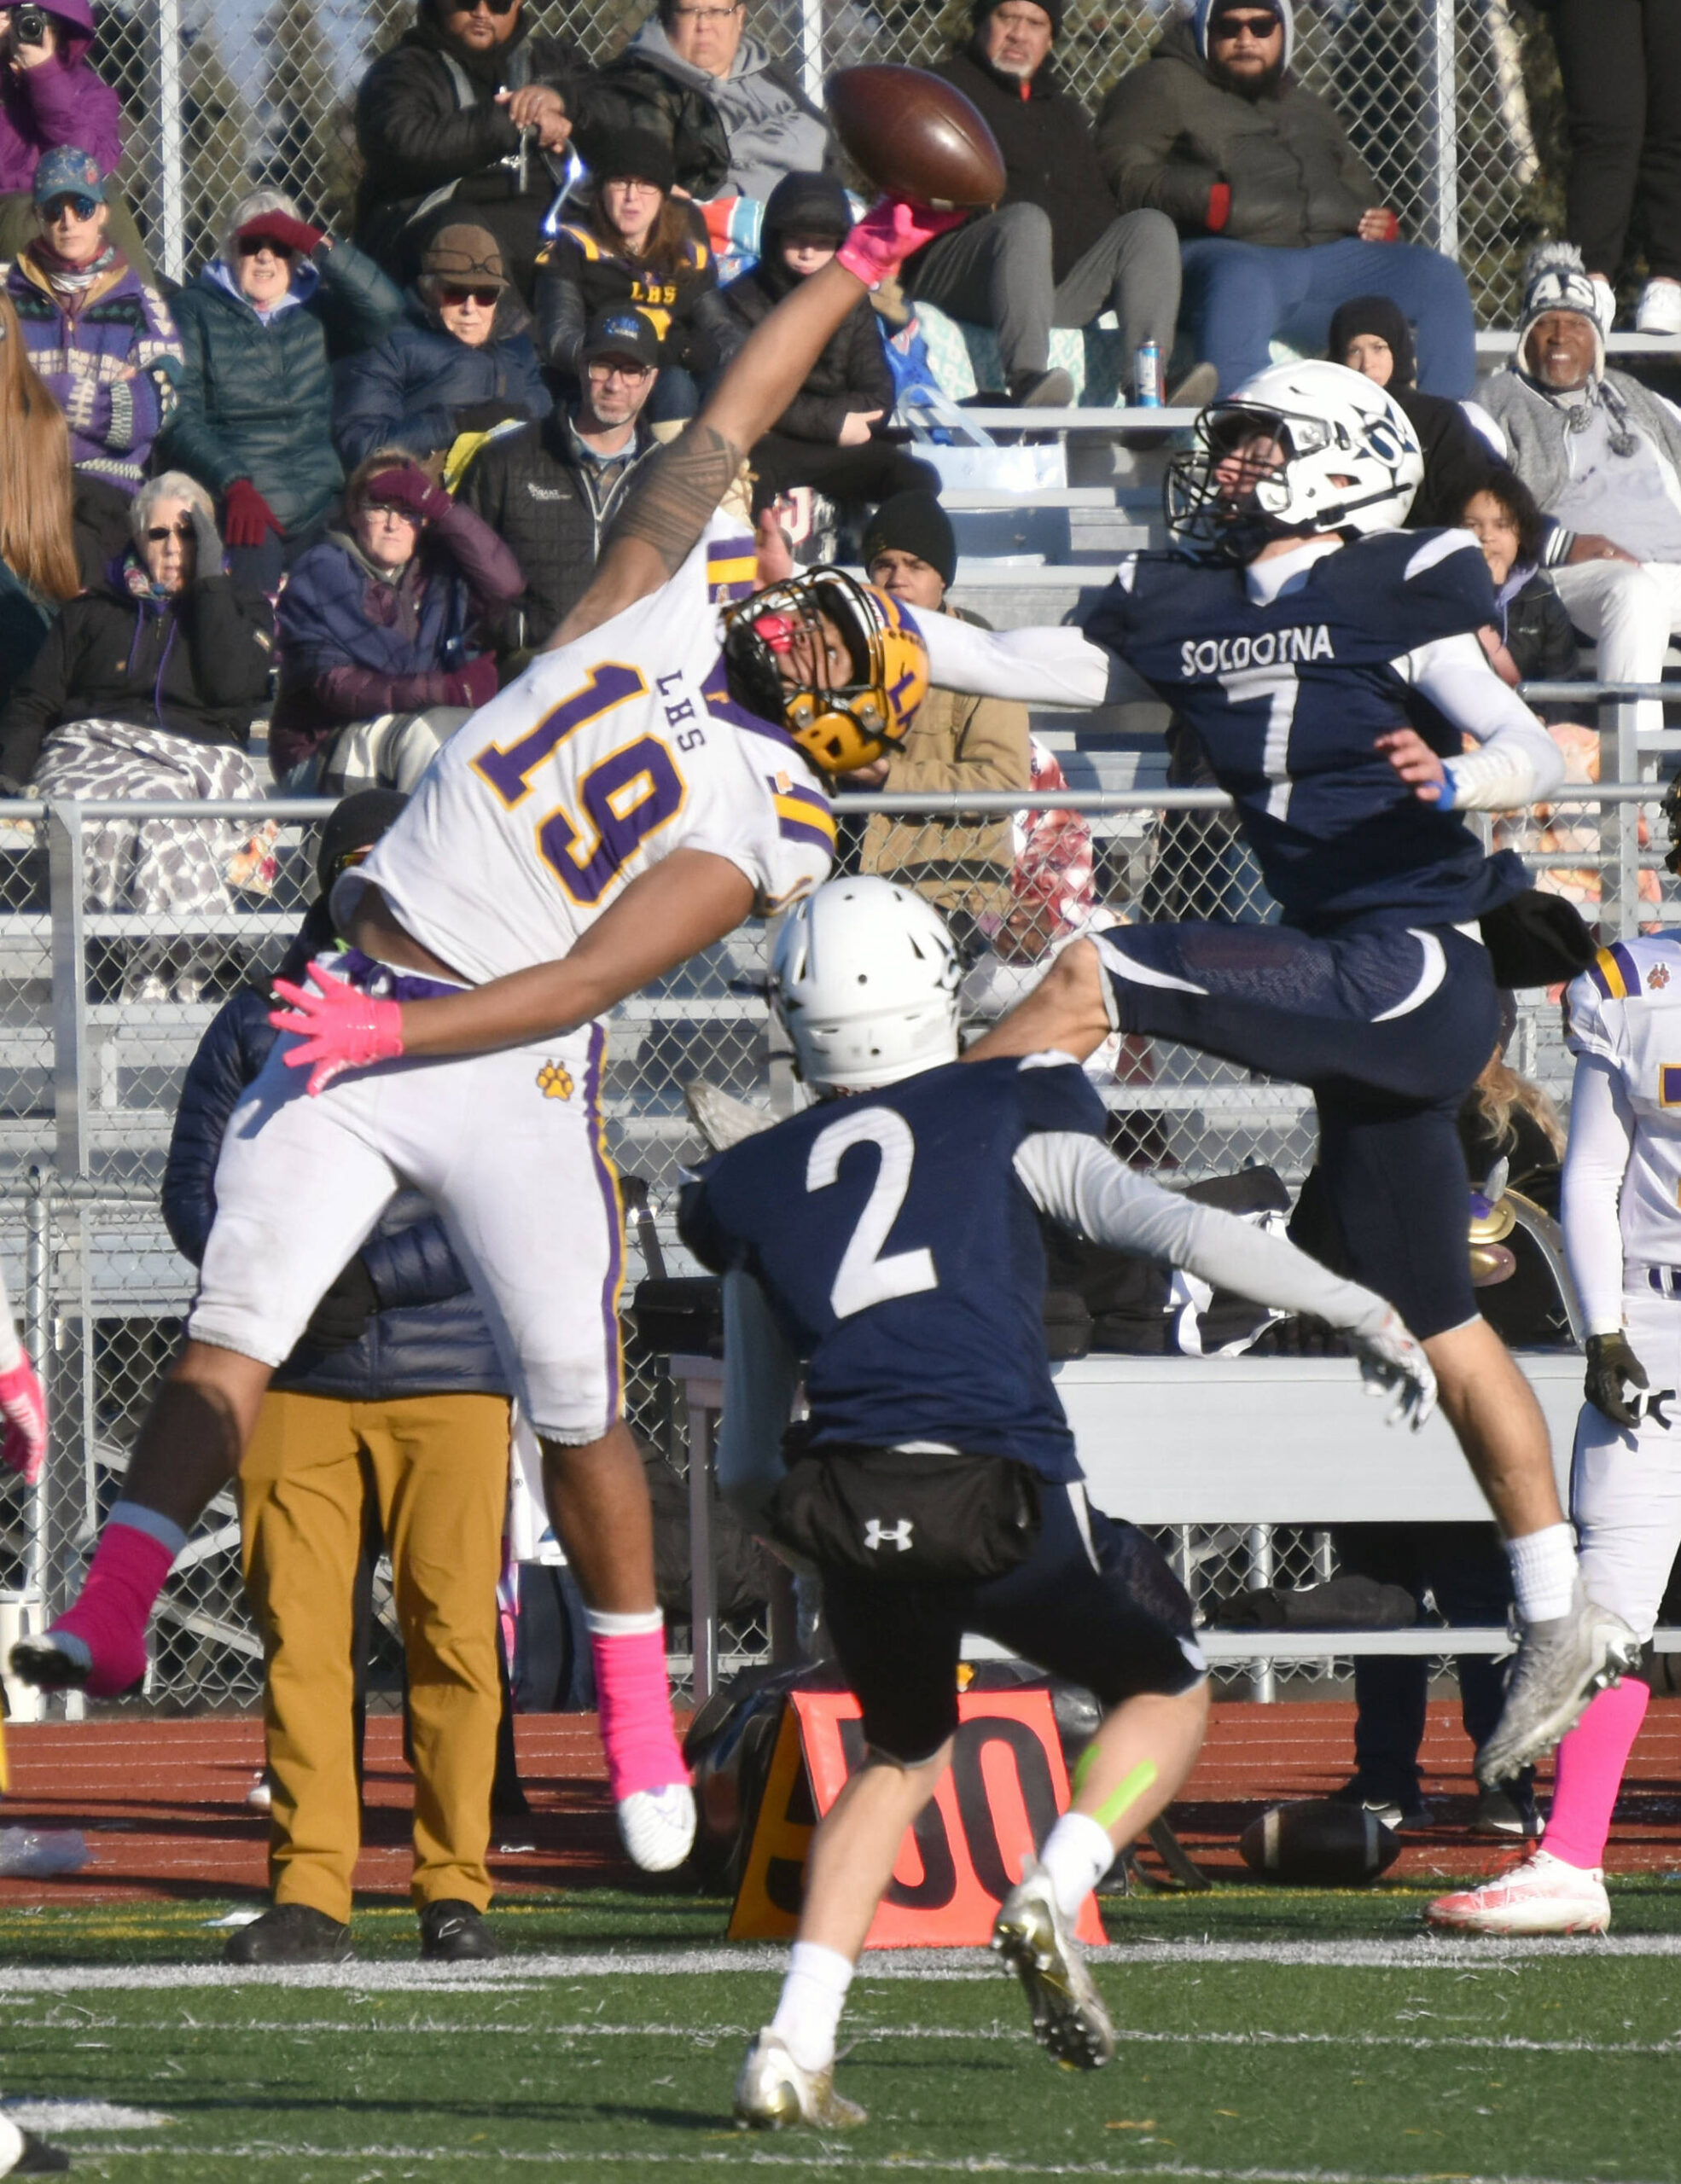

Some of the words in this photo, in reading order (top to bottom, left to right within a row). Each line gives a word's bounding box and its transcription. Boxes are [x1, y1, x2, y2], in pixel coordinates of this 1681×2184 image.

[655, 670, 707, 752] LHS
[1181, 624, 1335, 677] SOLDOTNA
[468, 660, 688, 909] 19
[1216, 662, 1300, 822] 7
[806, 1106, 938, 1320] 2
